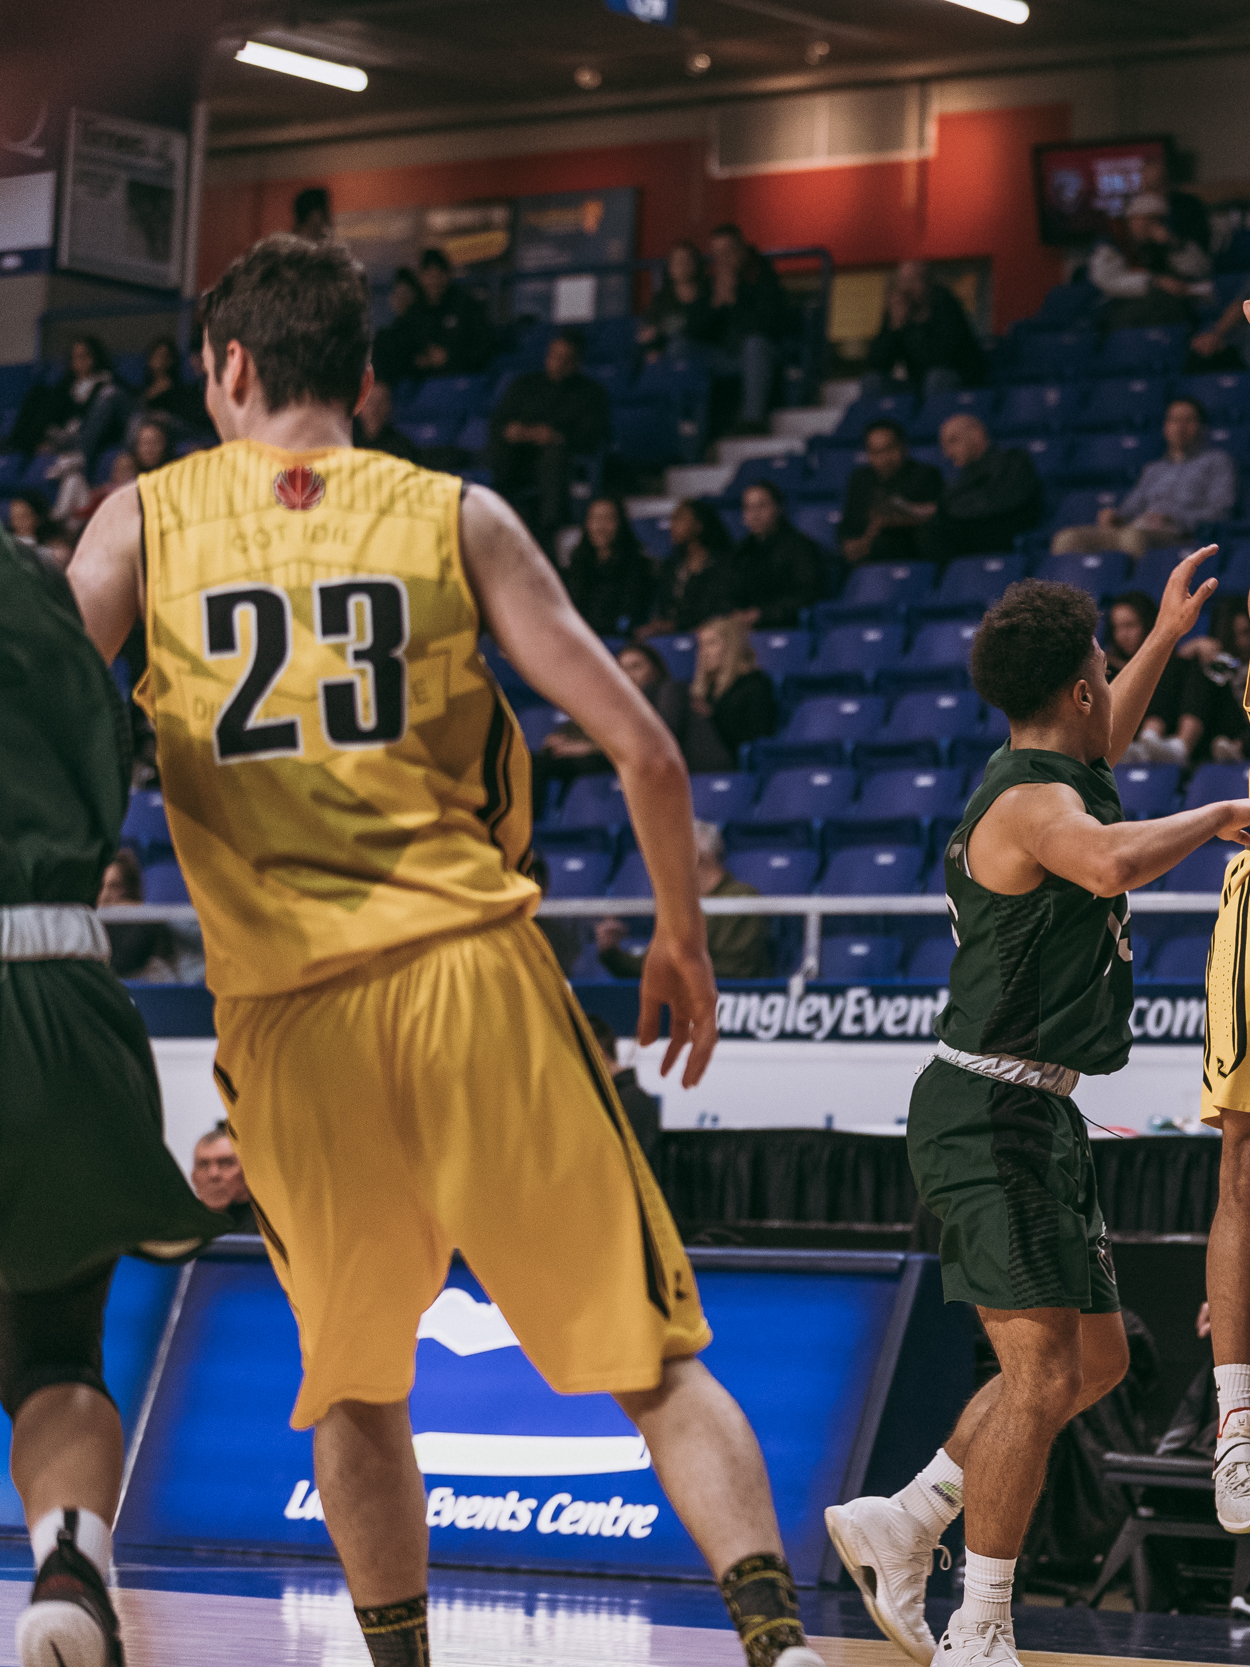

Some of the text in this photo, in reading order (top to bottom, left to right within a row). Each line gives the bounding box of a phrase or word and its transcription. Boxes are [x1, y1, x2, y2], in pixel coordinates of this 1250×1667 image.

[201, 575, 410, 766] 23
[1128, 997, 1207, 1038] com
[425, 1486, 659, 1539] Events Centre
